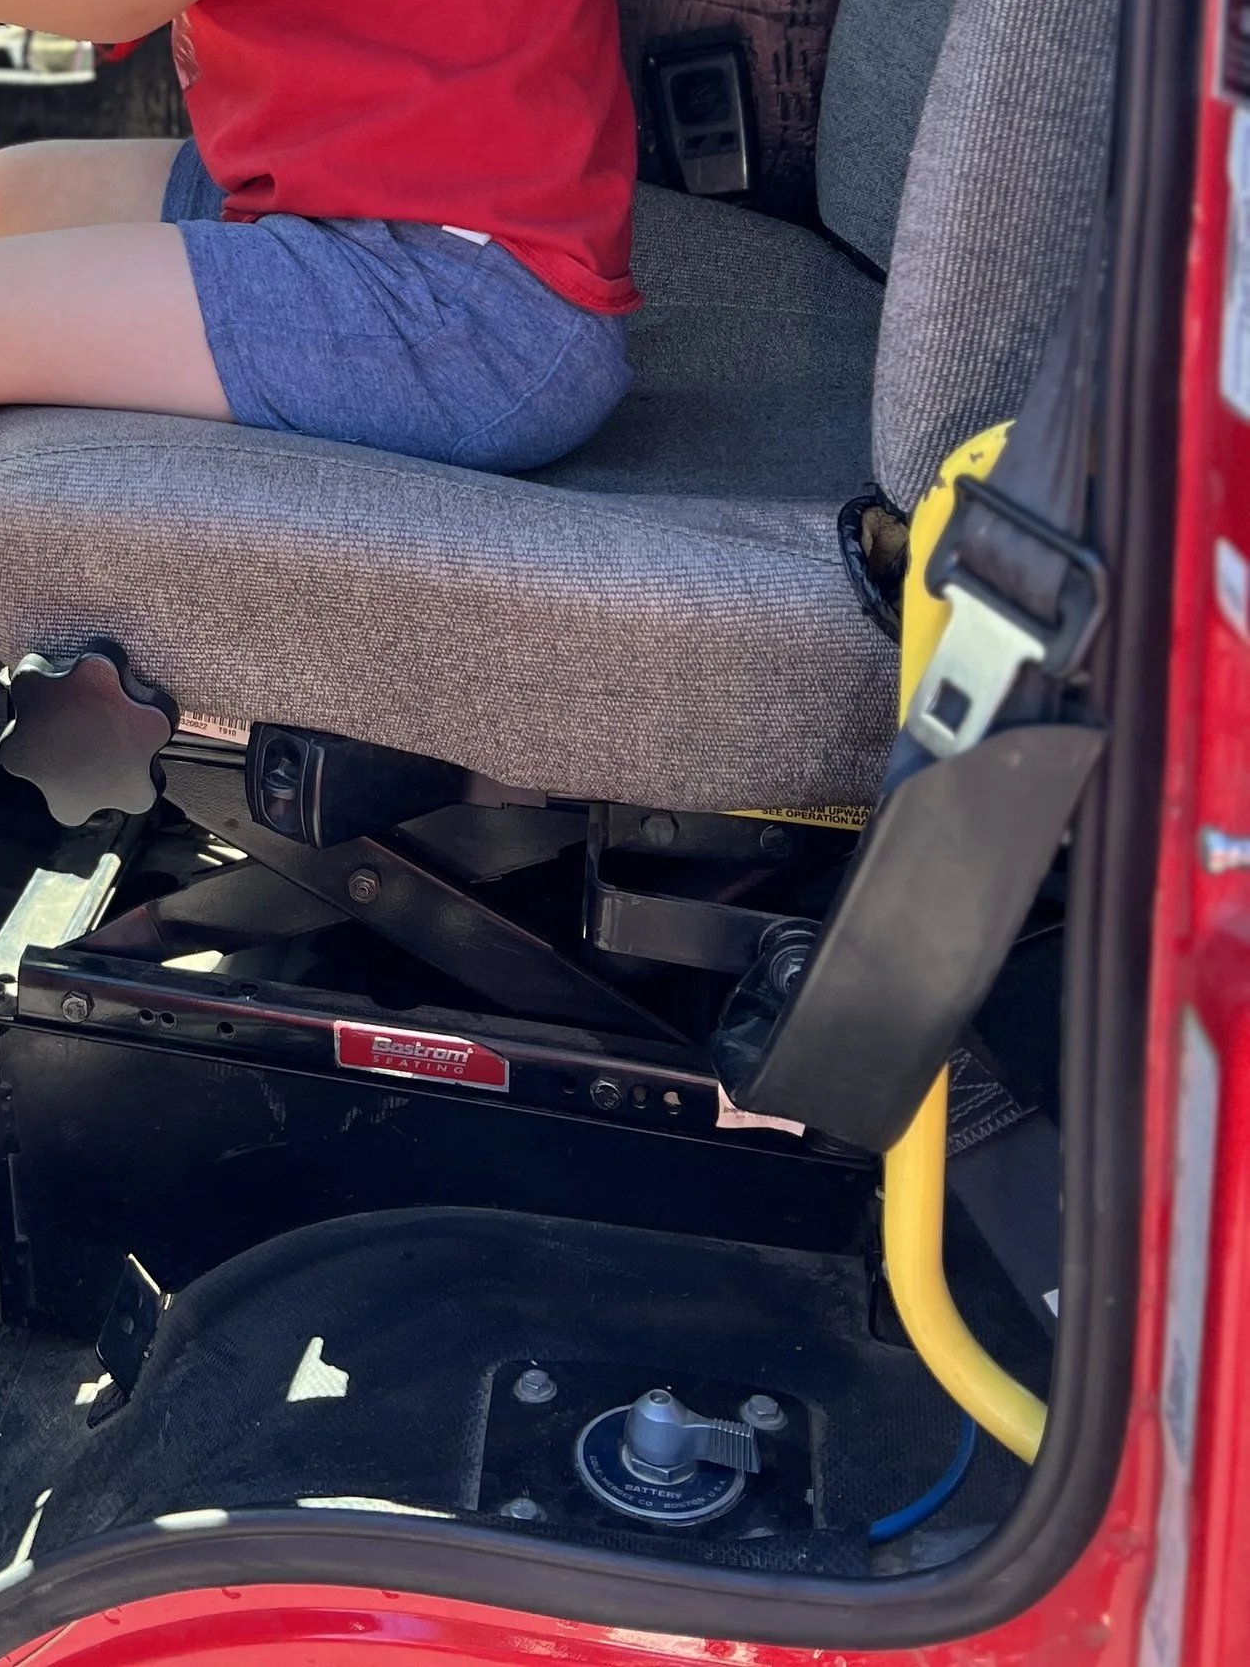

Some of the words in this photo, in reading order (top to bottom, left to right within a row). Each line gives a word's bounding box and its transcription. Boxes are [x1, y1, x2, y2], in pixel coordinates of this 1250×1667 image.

[786, 810, 848, 825] OPERATION
[851, 817, 866, 827] MA
[829, 806, 869, 819] UPWAR
[372, 1037, 468, 1063] Bostrom
[372, 1055, 465, 1075] SEATING
[625, 1484, 683, 1499] BATTERY
